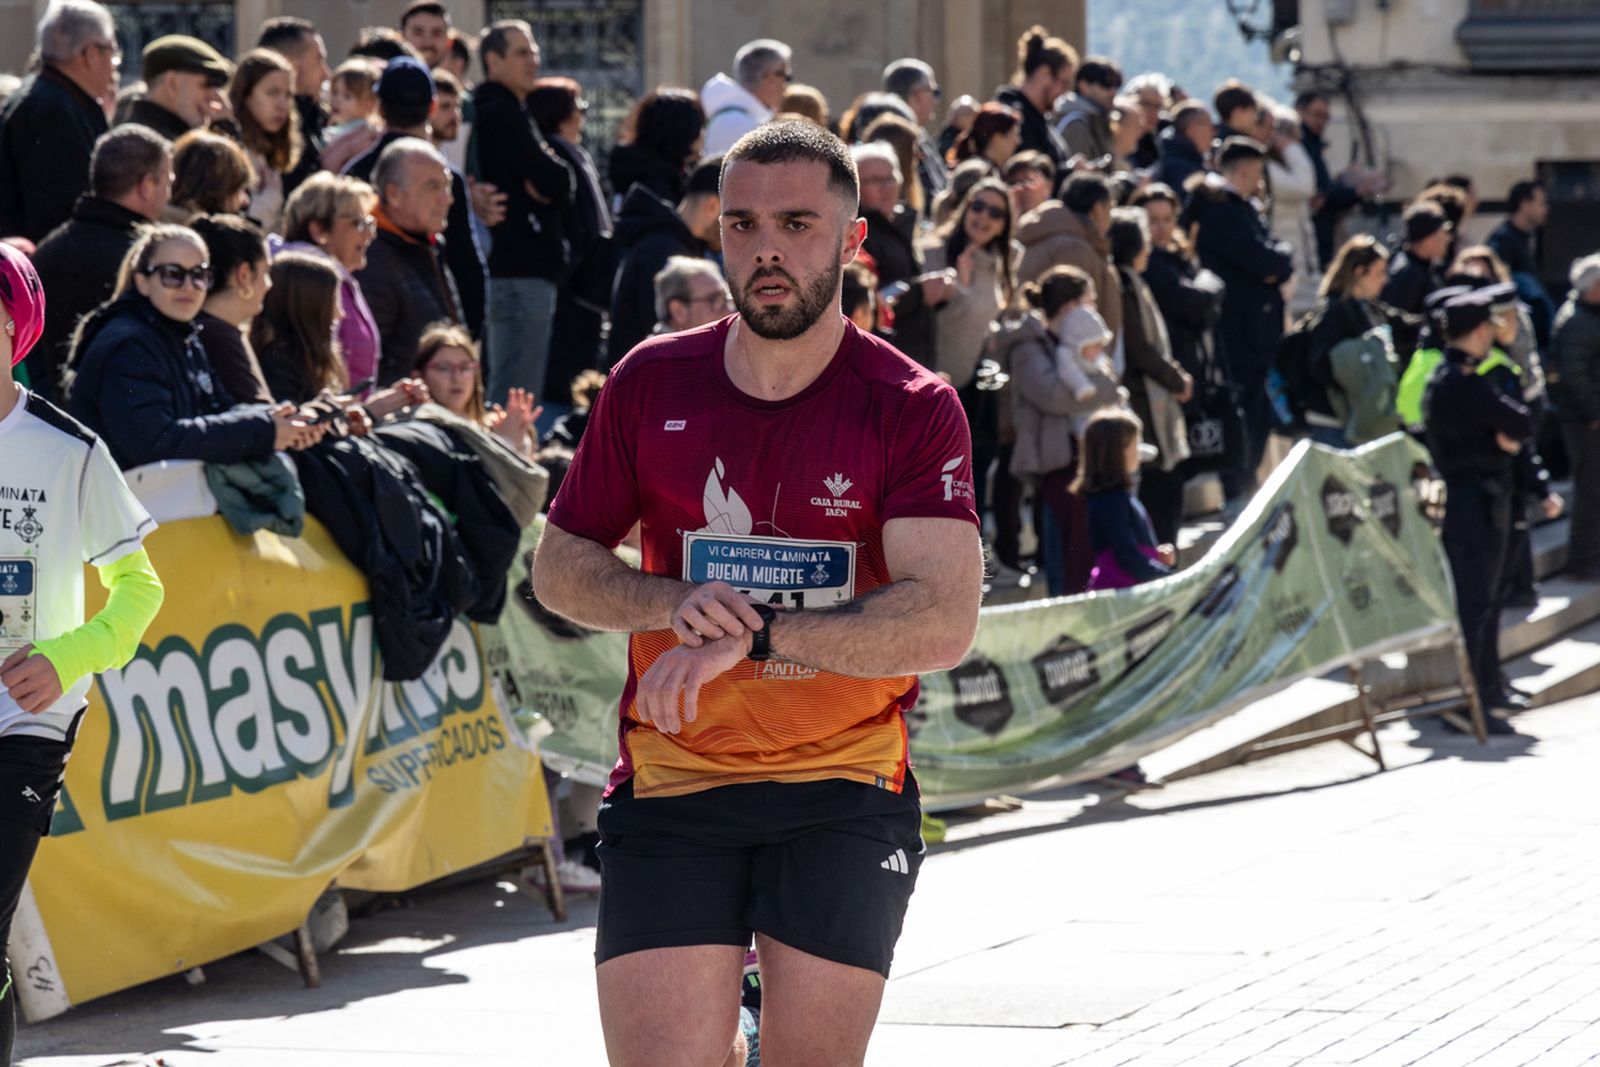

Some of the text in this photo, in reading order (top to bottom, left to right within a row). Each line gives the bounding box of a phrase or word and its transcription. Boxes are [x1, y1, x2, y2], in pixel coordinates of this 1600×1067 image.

[833, 499, 862, 509] RURAL
[708, 545, 832, 563] VI CARRERA CAMINATA
[706, 562, 804, 585] BUENA MUERTE
